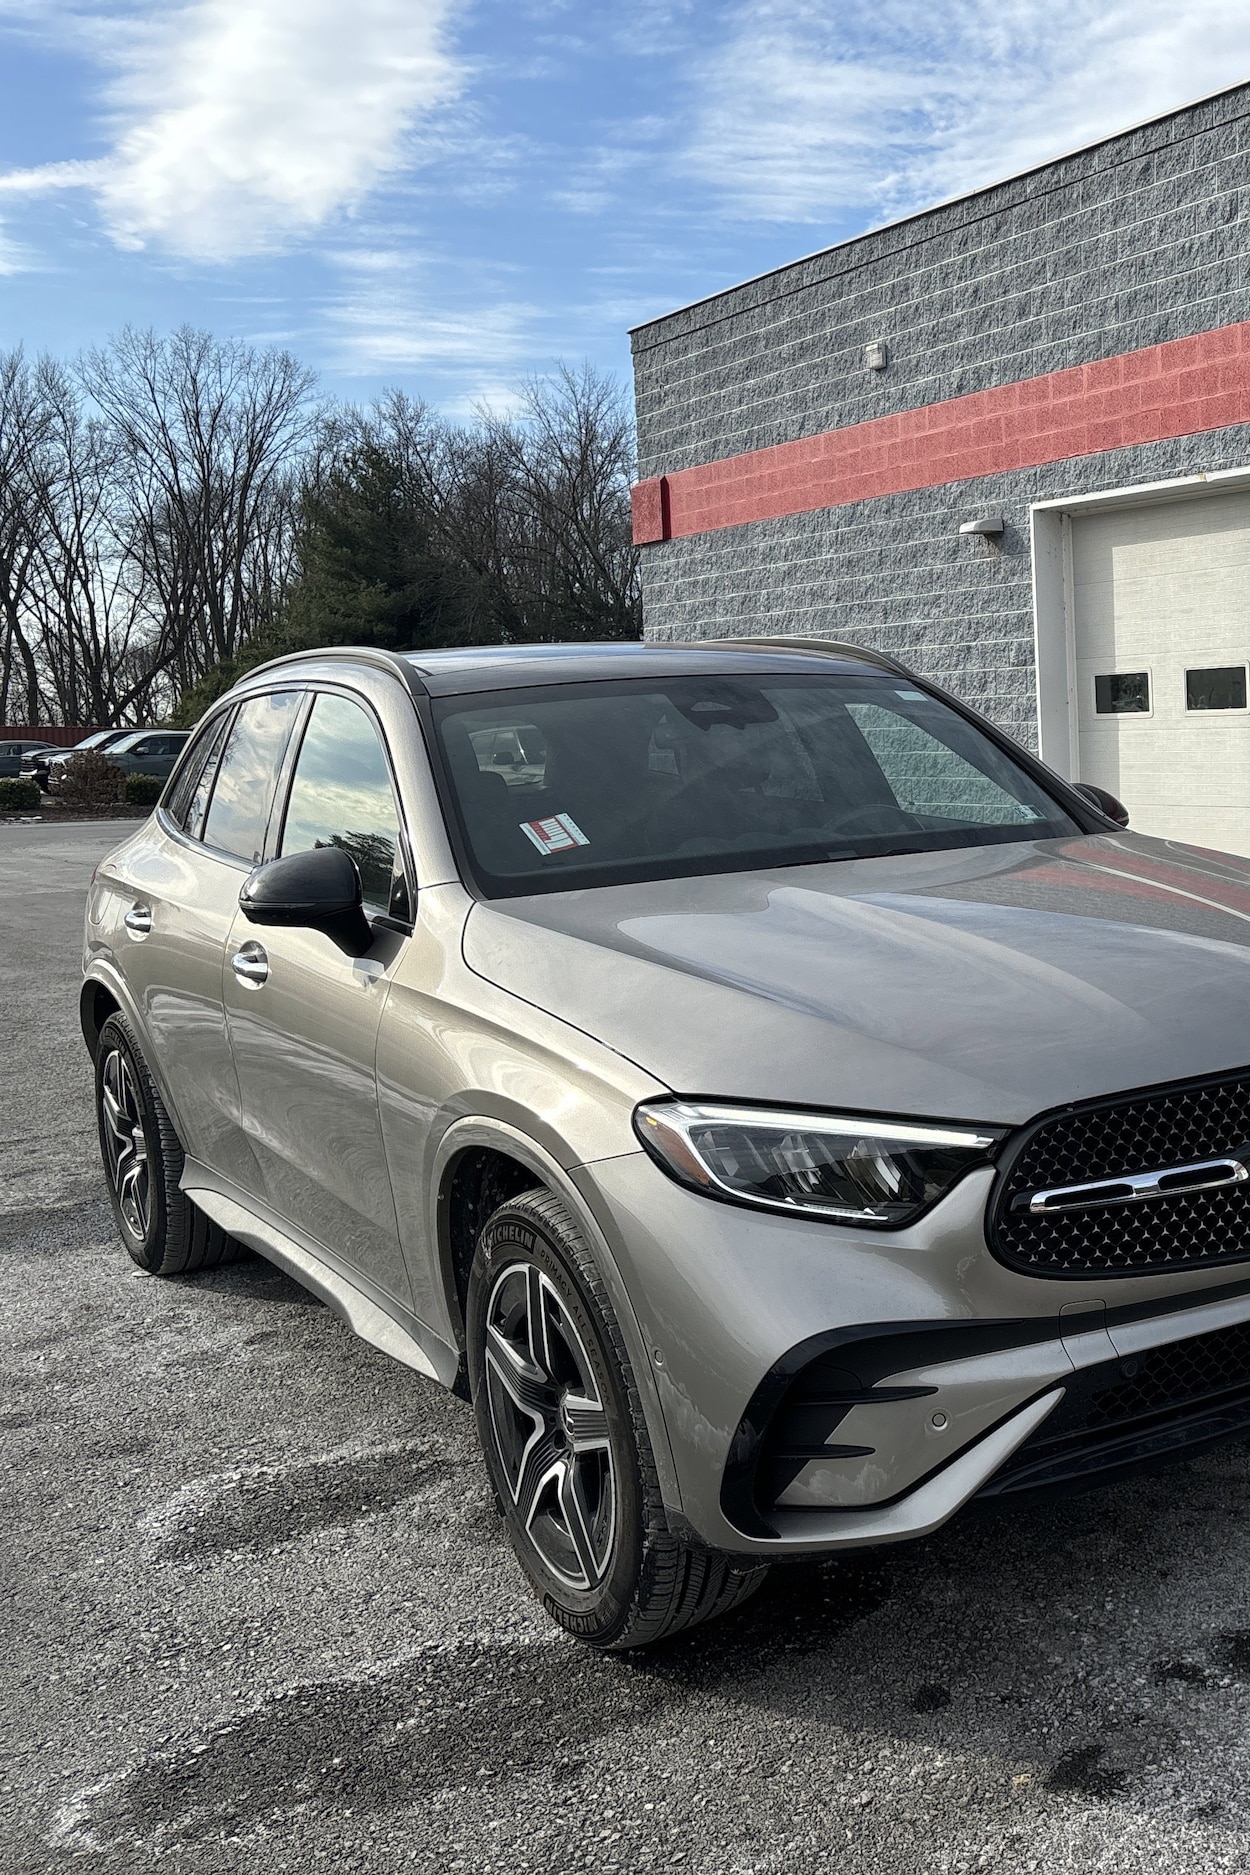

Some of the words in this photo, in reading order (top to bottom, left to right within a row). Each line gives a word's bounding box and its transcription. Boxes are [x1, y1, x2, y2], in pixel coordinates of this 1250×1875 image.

[486, 1225, 534, 1249] MICHELIN
[540, 1249, 572, 1298] PRIMACY
[572, 1305, 588, 1329] ALL
[586, 1338, 611, 1407] SEASON
[545, 1596, 599, 1633] MICHELIN
